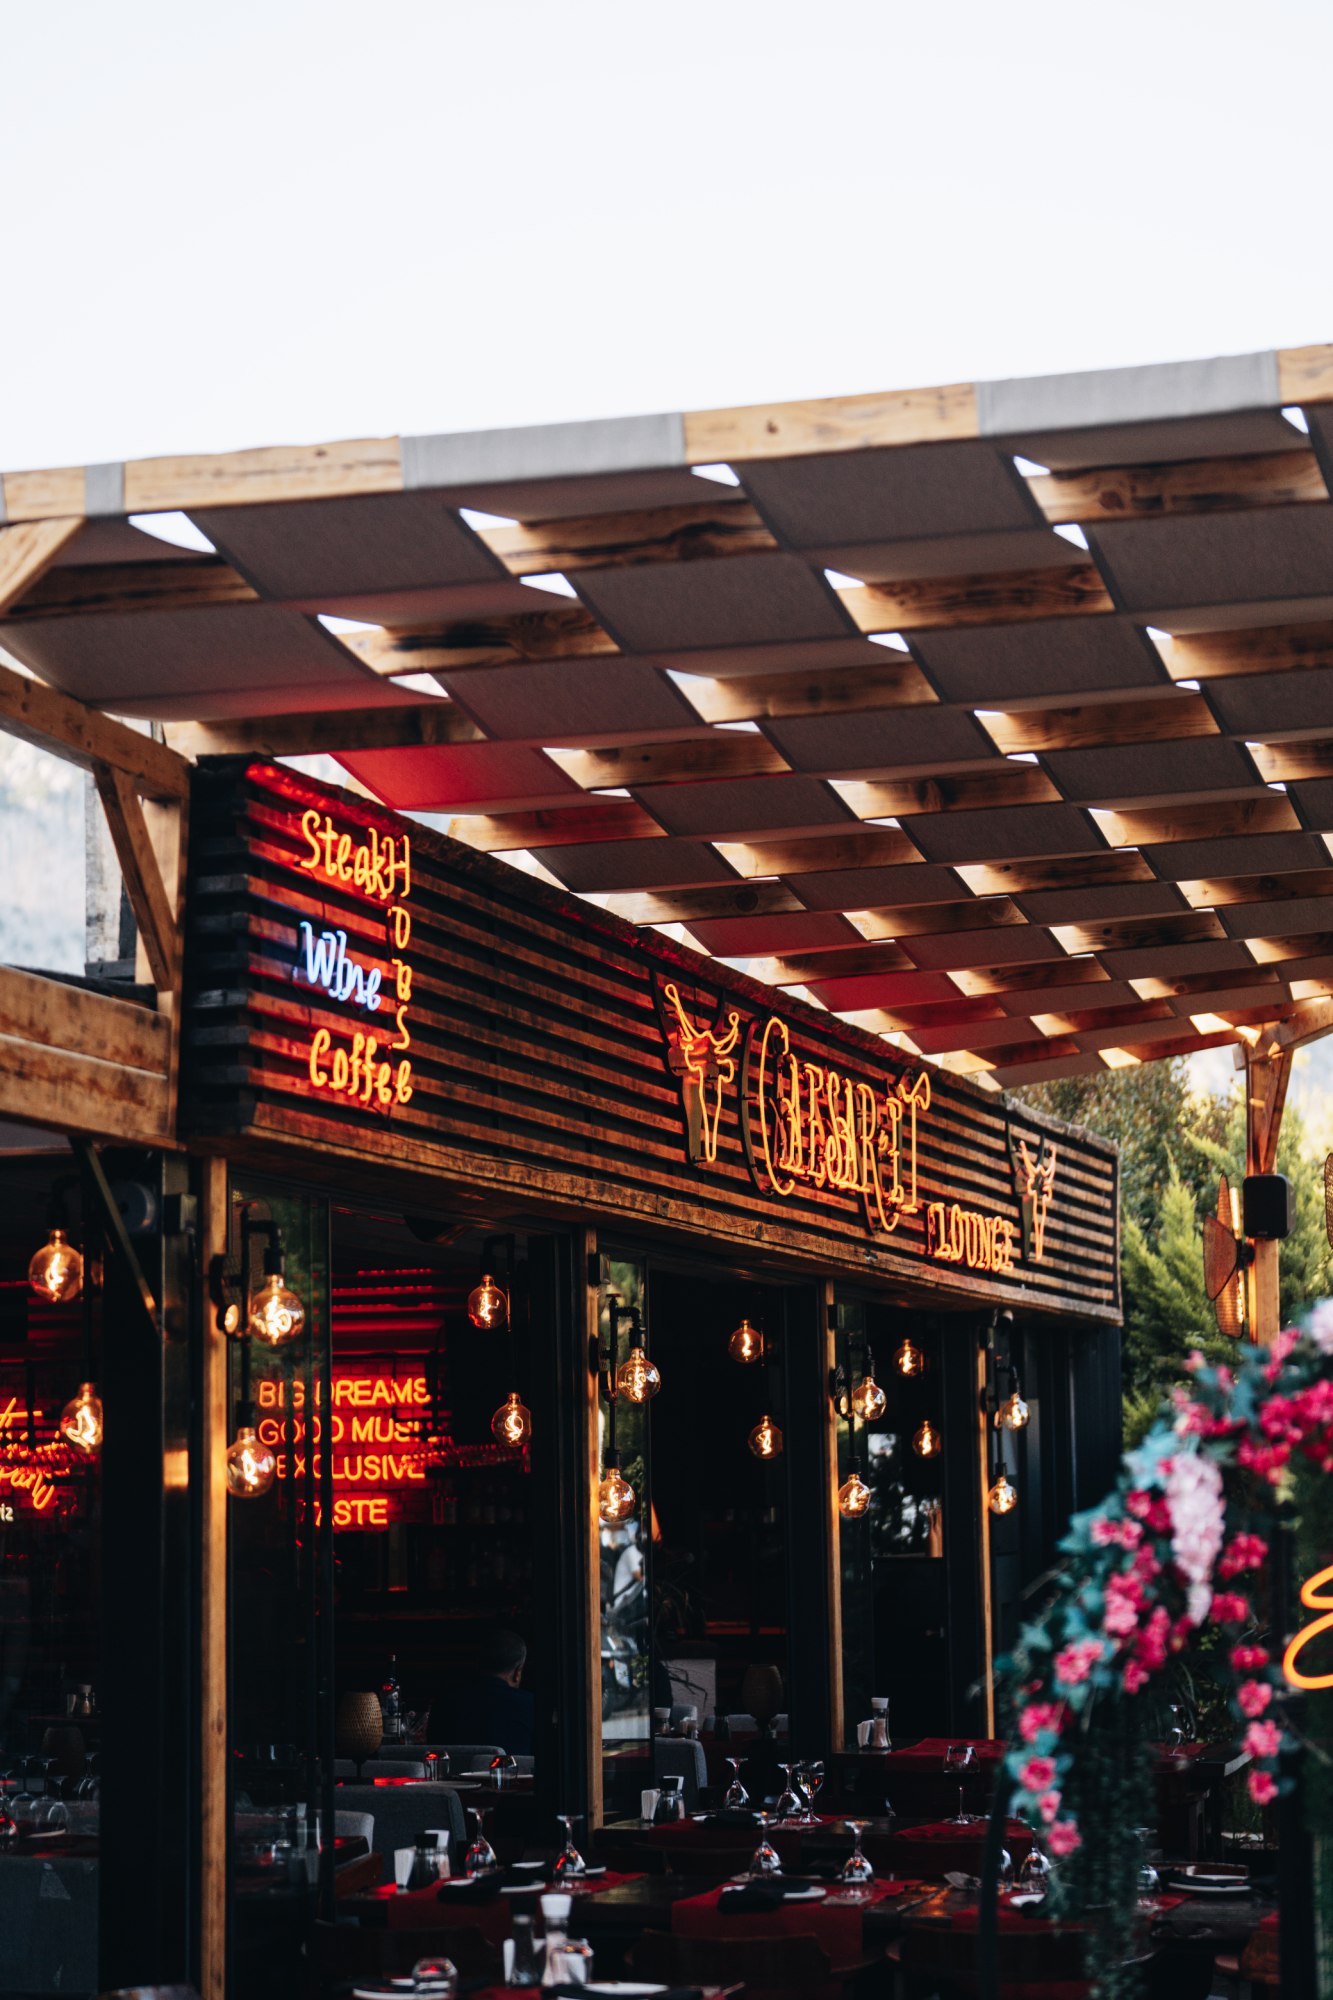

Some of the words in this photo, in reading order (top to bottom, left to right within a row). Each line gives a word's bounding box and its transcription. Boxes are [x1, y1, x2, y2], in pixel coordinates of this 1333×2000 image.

[301, 810, 388, 899] Steak
[299, 921, 382, 1012] Wine
[309, 1028, 413, 1104] Coffee
[930, 1202, 1015, 1272] LOUNGE
[259, 1381, 305, 1407] BIG
[303, 1498, 388, 1526] STE
